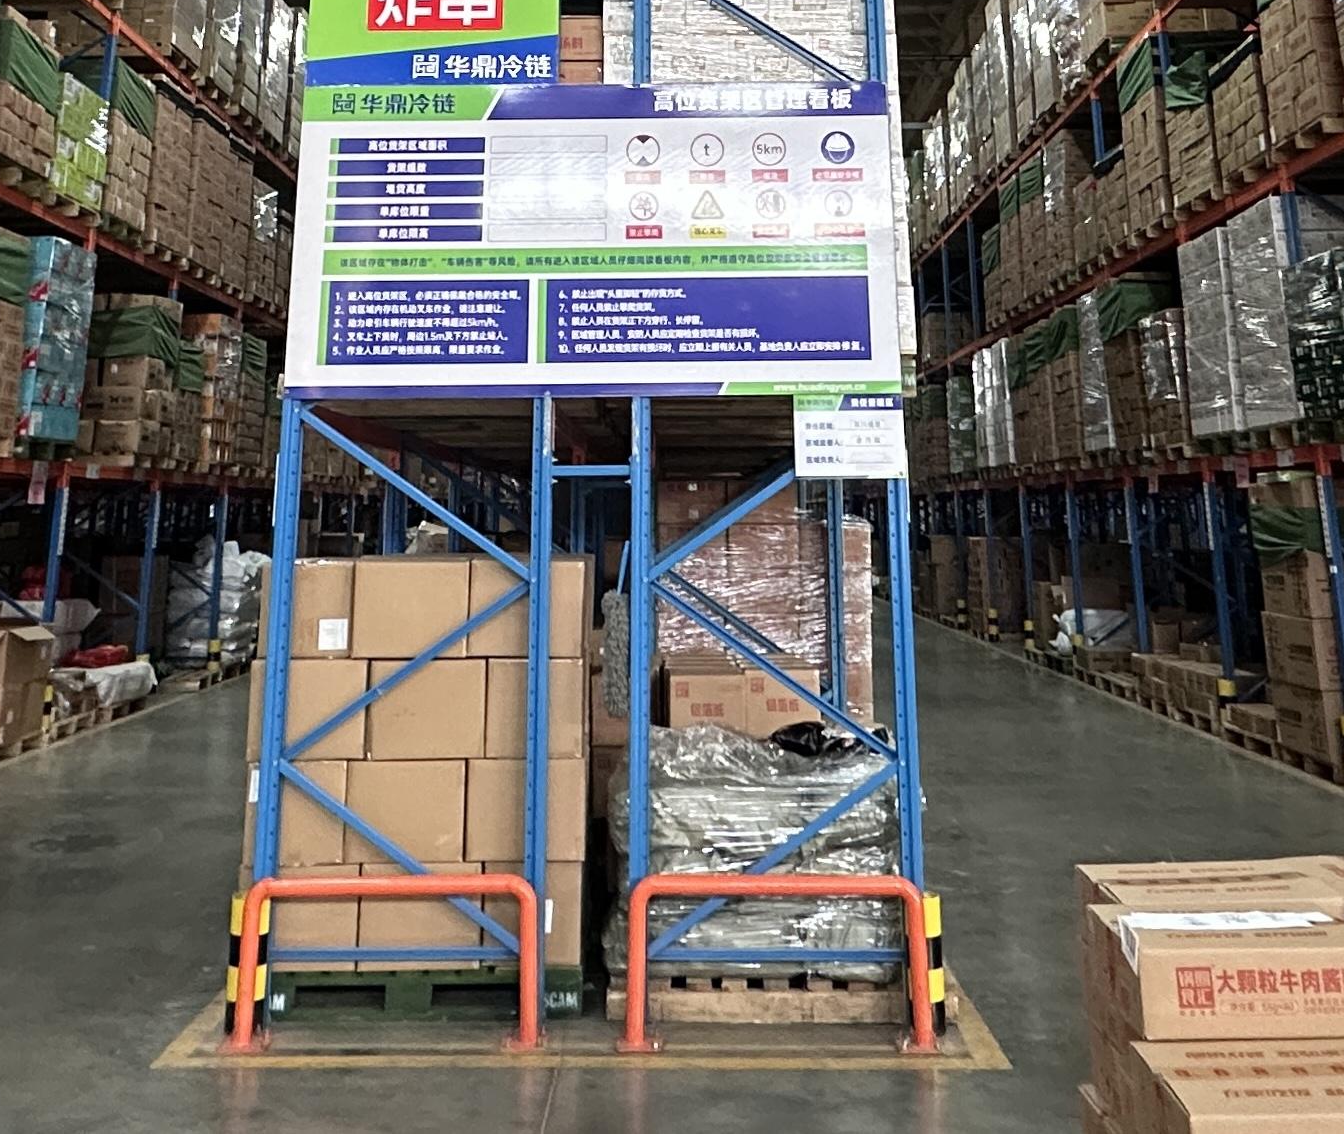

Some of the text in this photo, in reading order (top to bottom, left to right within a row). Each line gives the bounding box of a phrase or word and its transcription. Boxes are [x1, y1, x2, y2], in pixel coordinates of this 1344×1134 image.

[443, 54, 552, 79] 华鼎冷链
[360, 92, 456, 115] 华鼎冷链
[653, 87, 852, 112] 高位货架区管理看板
[756, 142, 783, 156] 5km
[1216, 968, 1342, 994] 大颗粒牛肉酱
